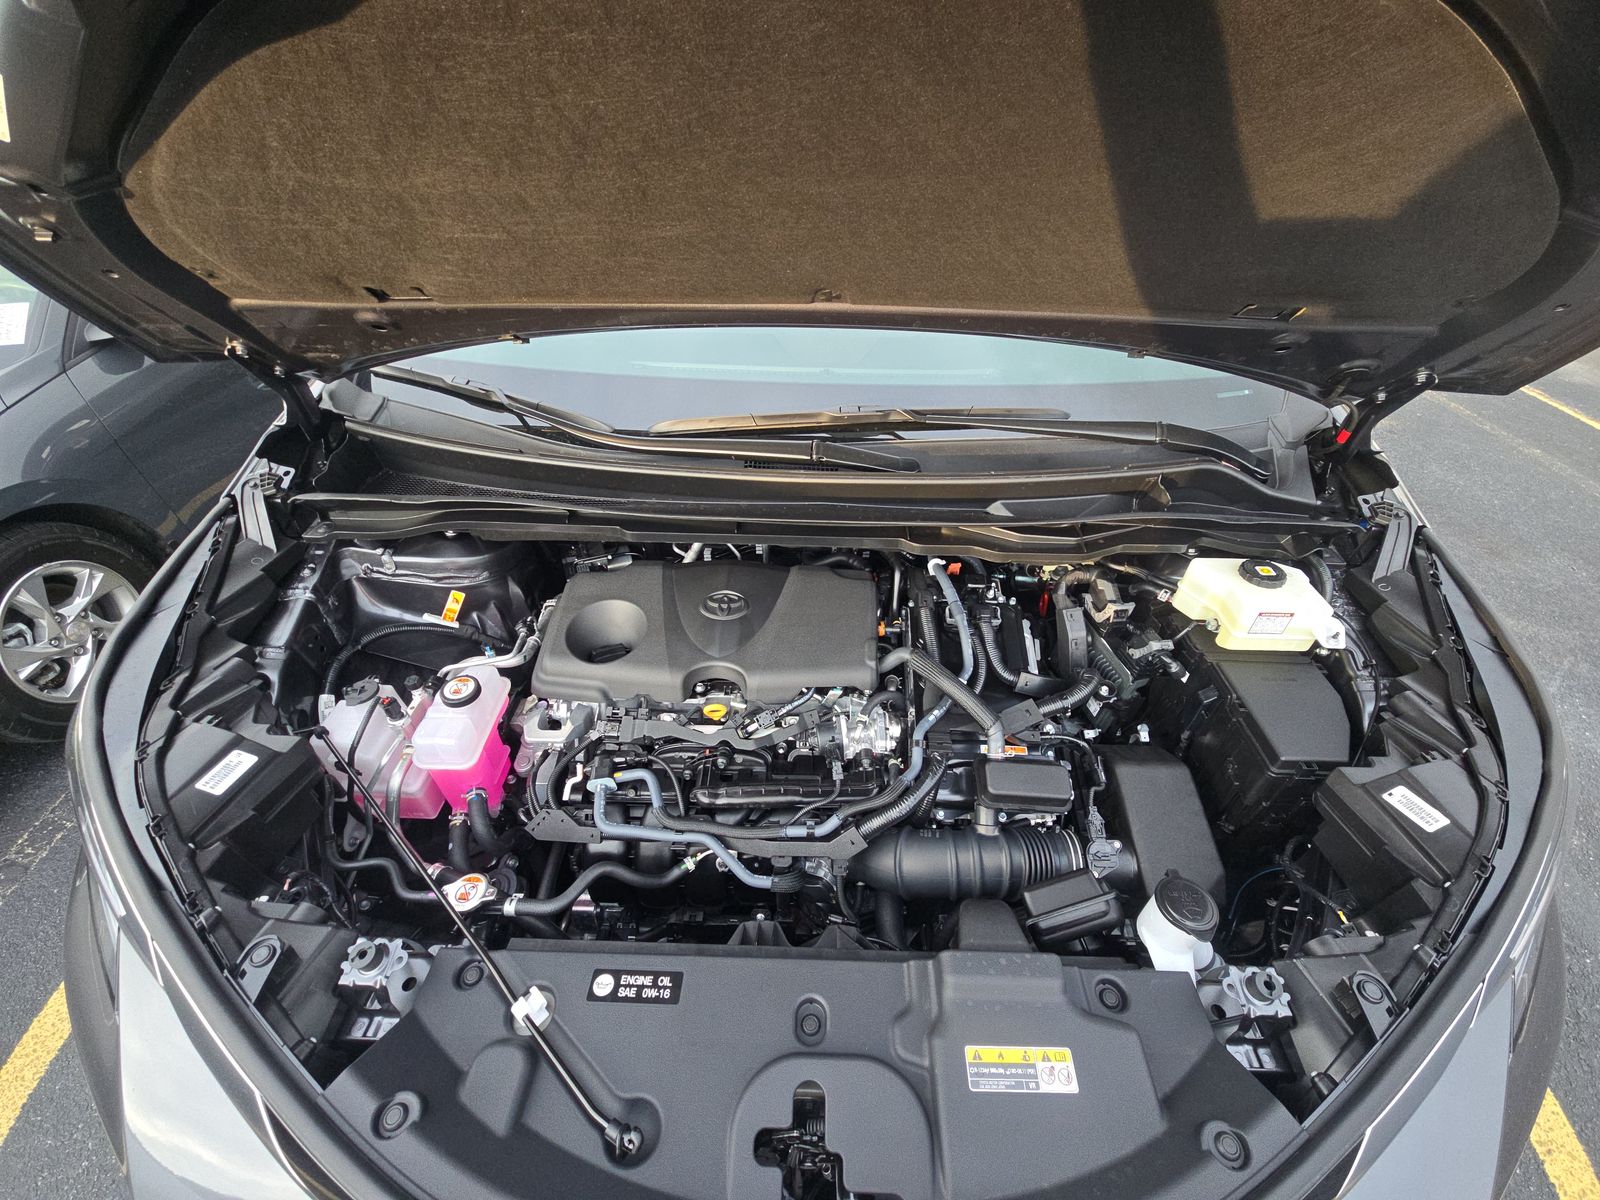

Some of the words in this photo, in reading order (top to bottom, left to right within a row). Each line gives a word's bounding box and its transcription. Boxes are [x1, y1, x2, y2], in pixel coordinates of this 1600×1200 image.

[620, 975, 653, 986] ENGINE
[658, 976, 672, 987] OIL
[617, 987, 637, 998] SAE
[642, 988, 671, 999] 0W-16
